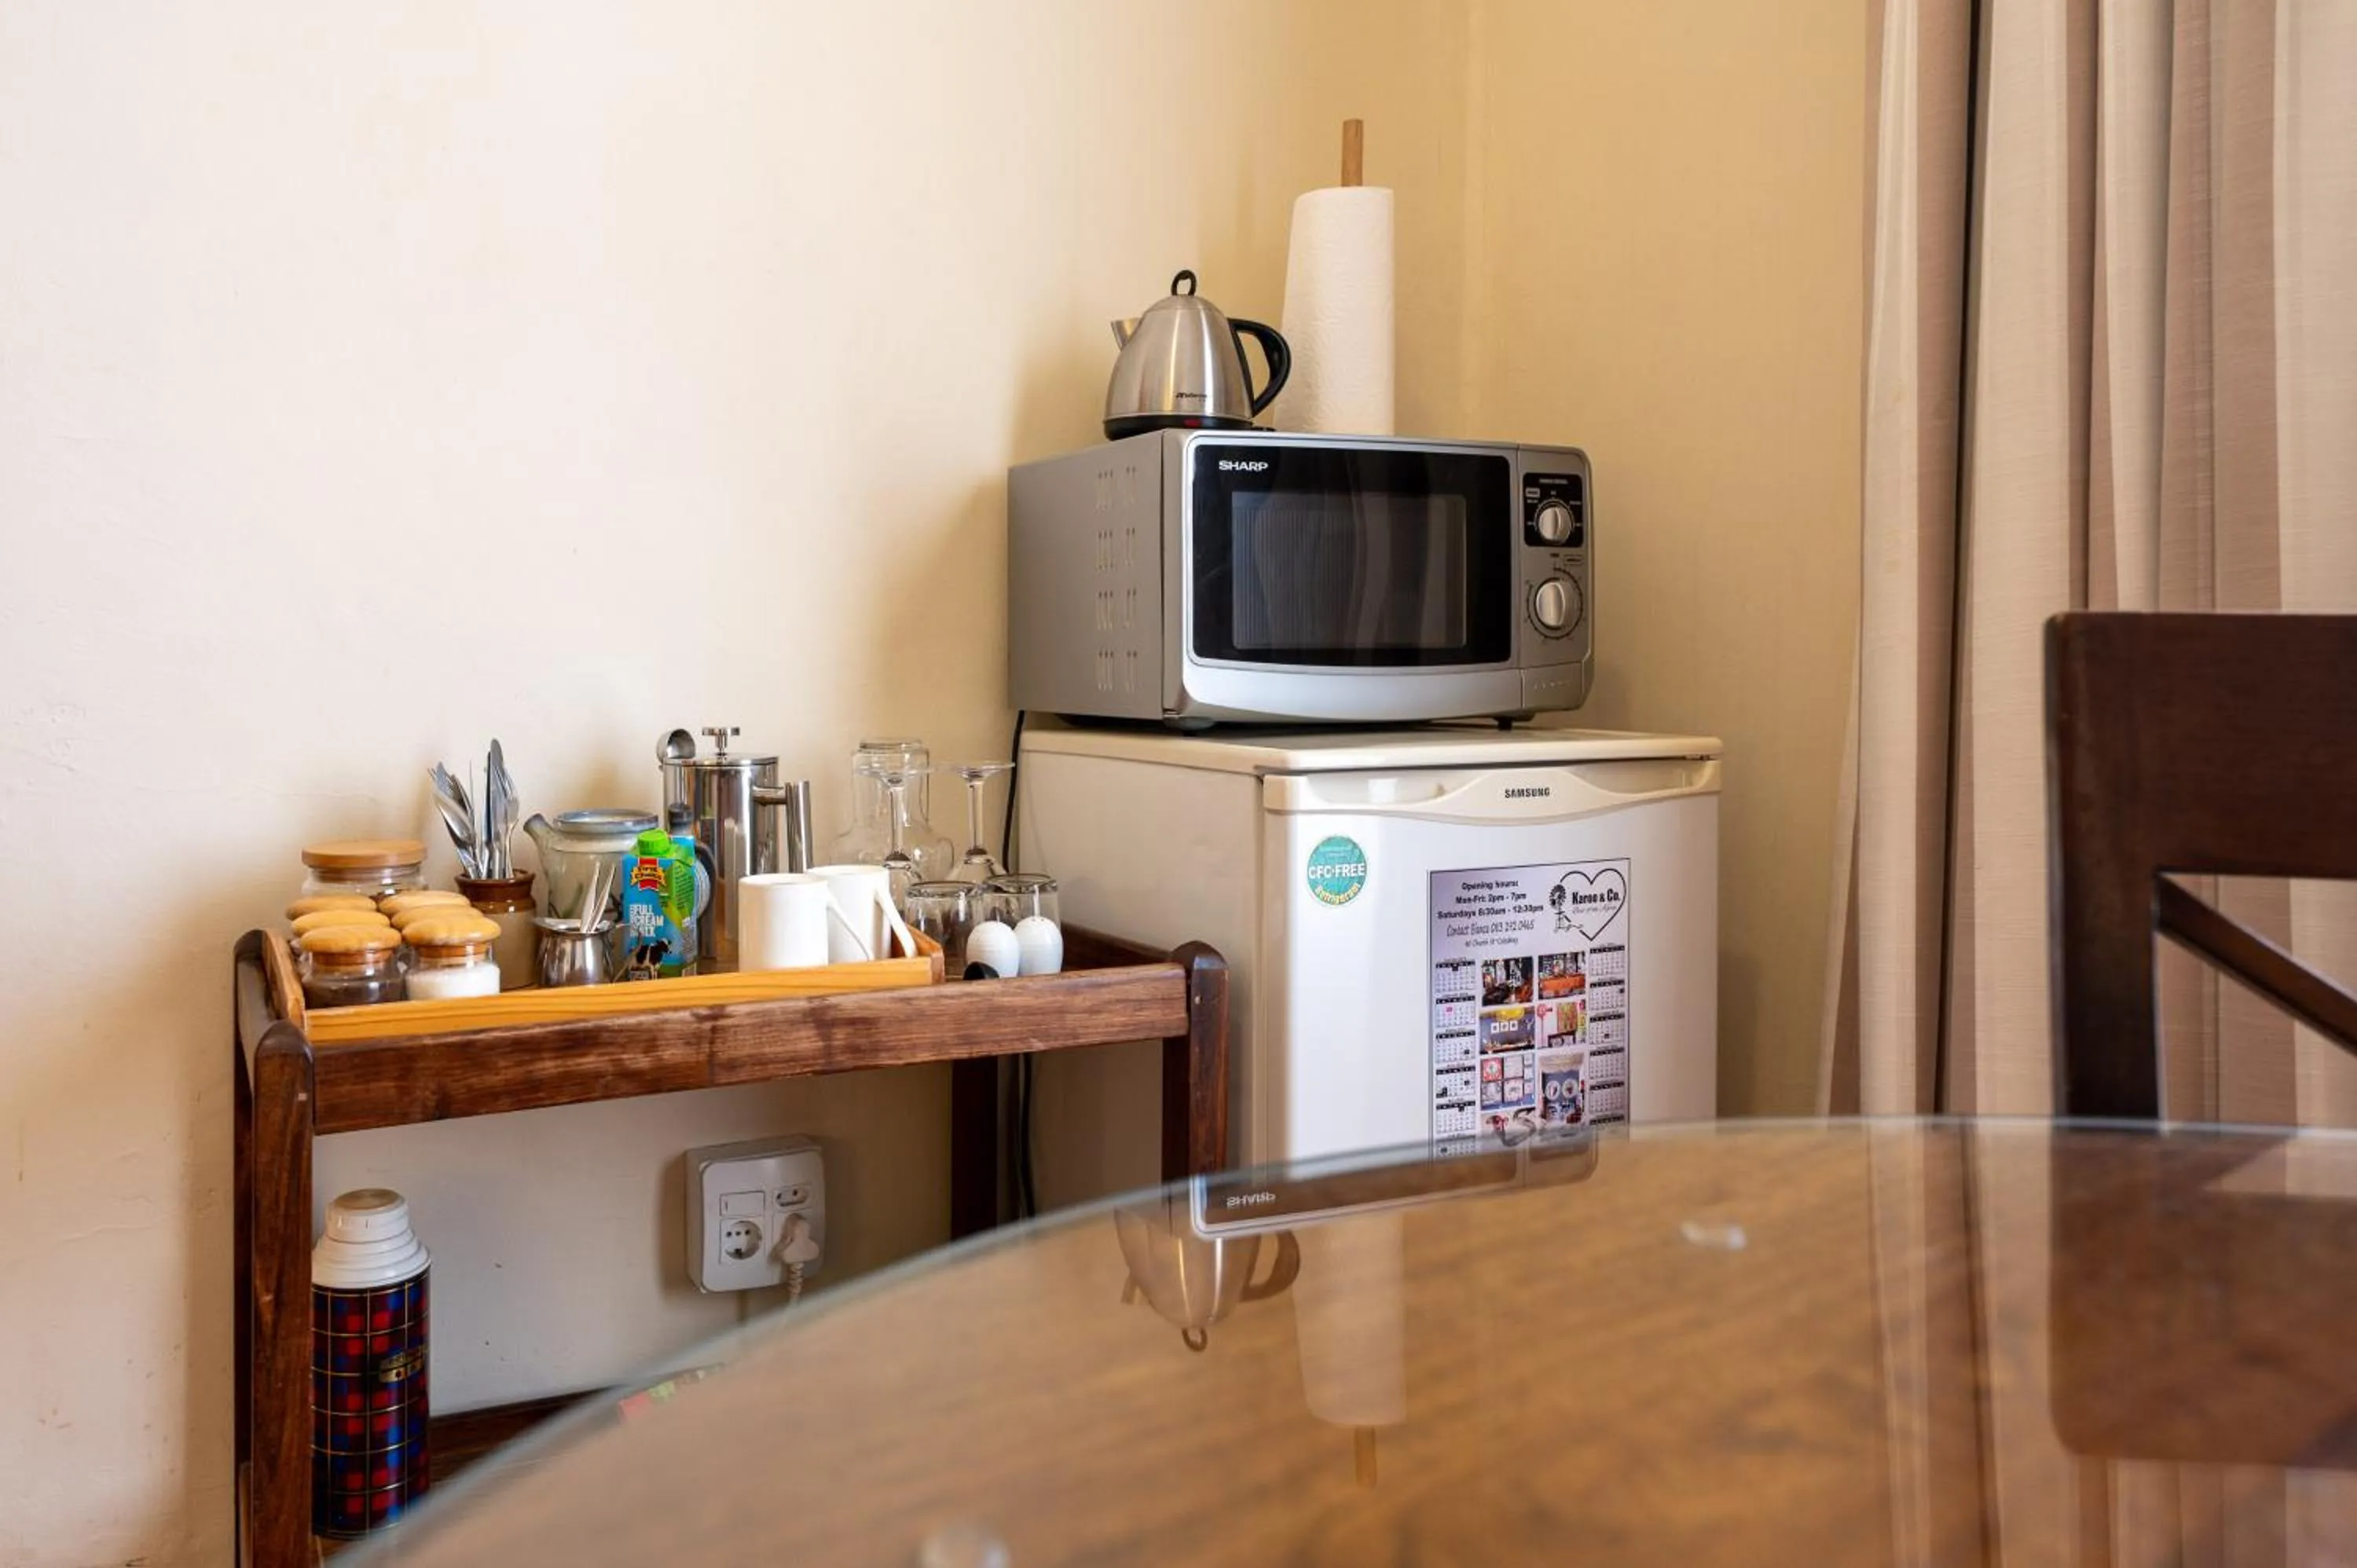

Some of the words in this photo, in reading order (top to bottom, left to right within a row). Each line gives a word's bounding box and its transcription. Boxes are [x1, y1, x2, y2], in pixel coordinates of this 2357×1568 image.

[1219, 460, 1269, 472] SHARP
[1505, 787, 1550, 799] SAMSUNG
[1461, 881, 1494, 892] Opening
[1511, 892, 1527, 902] 7pm
[1572, 891, 1598, 905] Karoo
[1600, 892, 1605, 903] &
[1437, 910, 1476, 919] Saturdays
